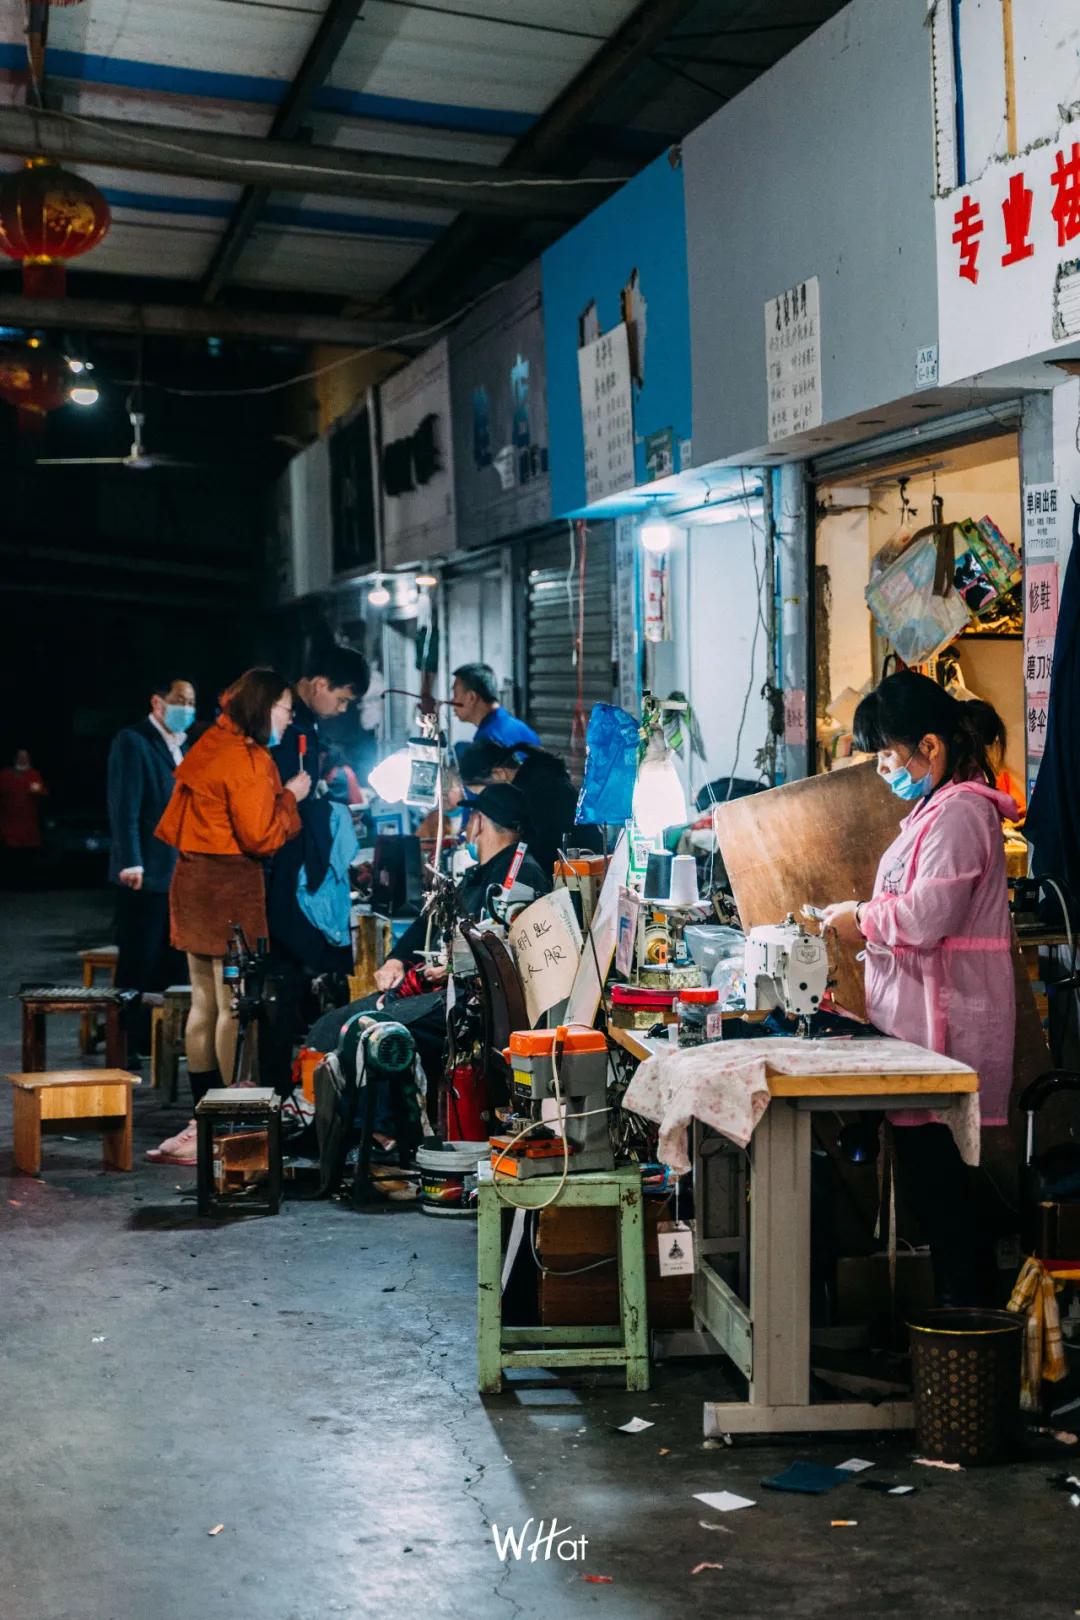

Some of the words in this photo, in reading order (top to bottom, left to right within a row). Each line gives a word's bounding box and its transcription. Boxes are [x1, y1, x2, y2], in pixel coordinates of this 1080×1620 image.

[1026, 489, 1057, 515] 单间出租
[1029, 580, 1051, 613] 修鞋
[1029, 706, 1047, 734] 修伞
